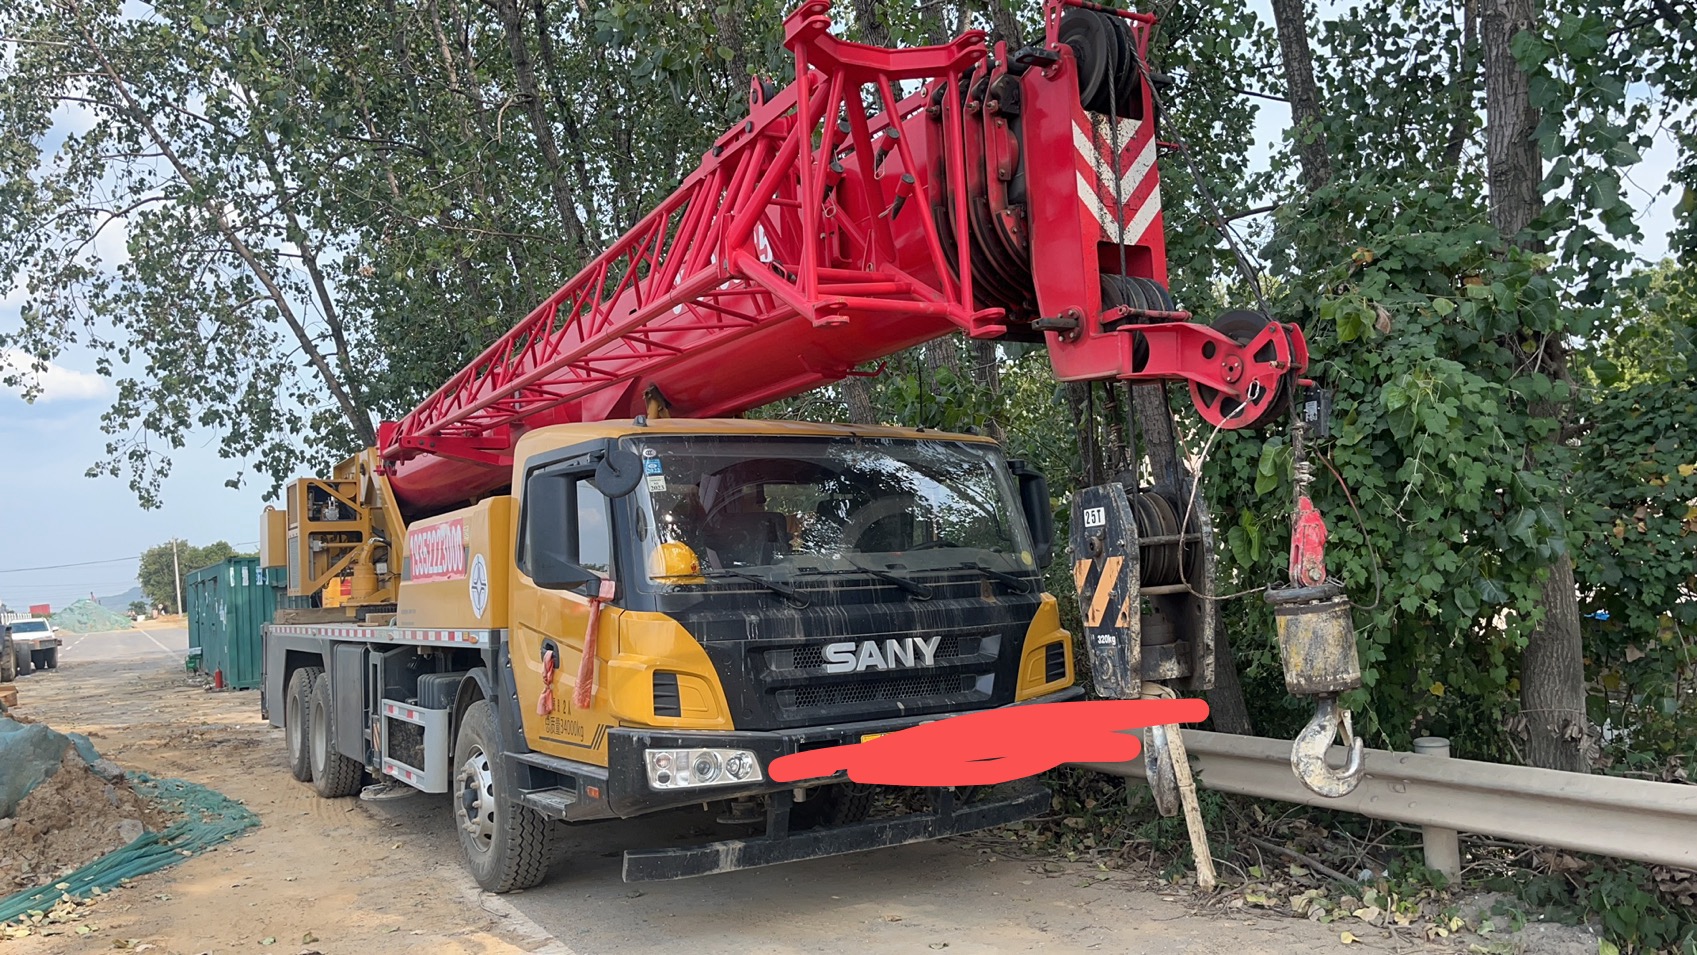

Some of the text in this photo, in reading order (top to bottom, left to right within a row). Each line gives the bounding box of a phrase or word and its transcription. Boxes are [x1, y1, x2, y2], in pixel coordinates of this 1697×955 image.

[1085, 509, 1101, 525] 25T
[1097, 634, 1117, 646] 320kg
[824, 637, 941, 674] SANY
